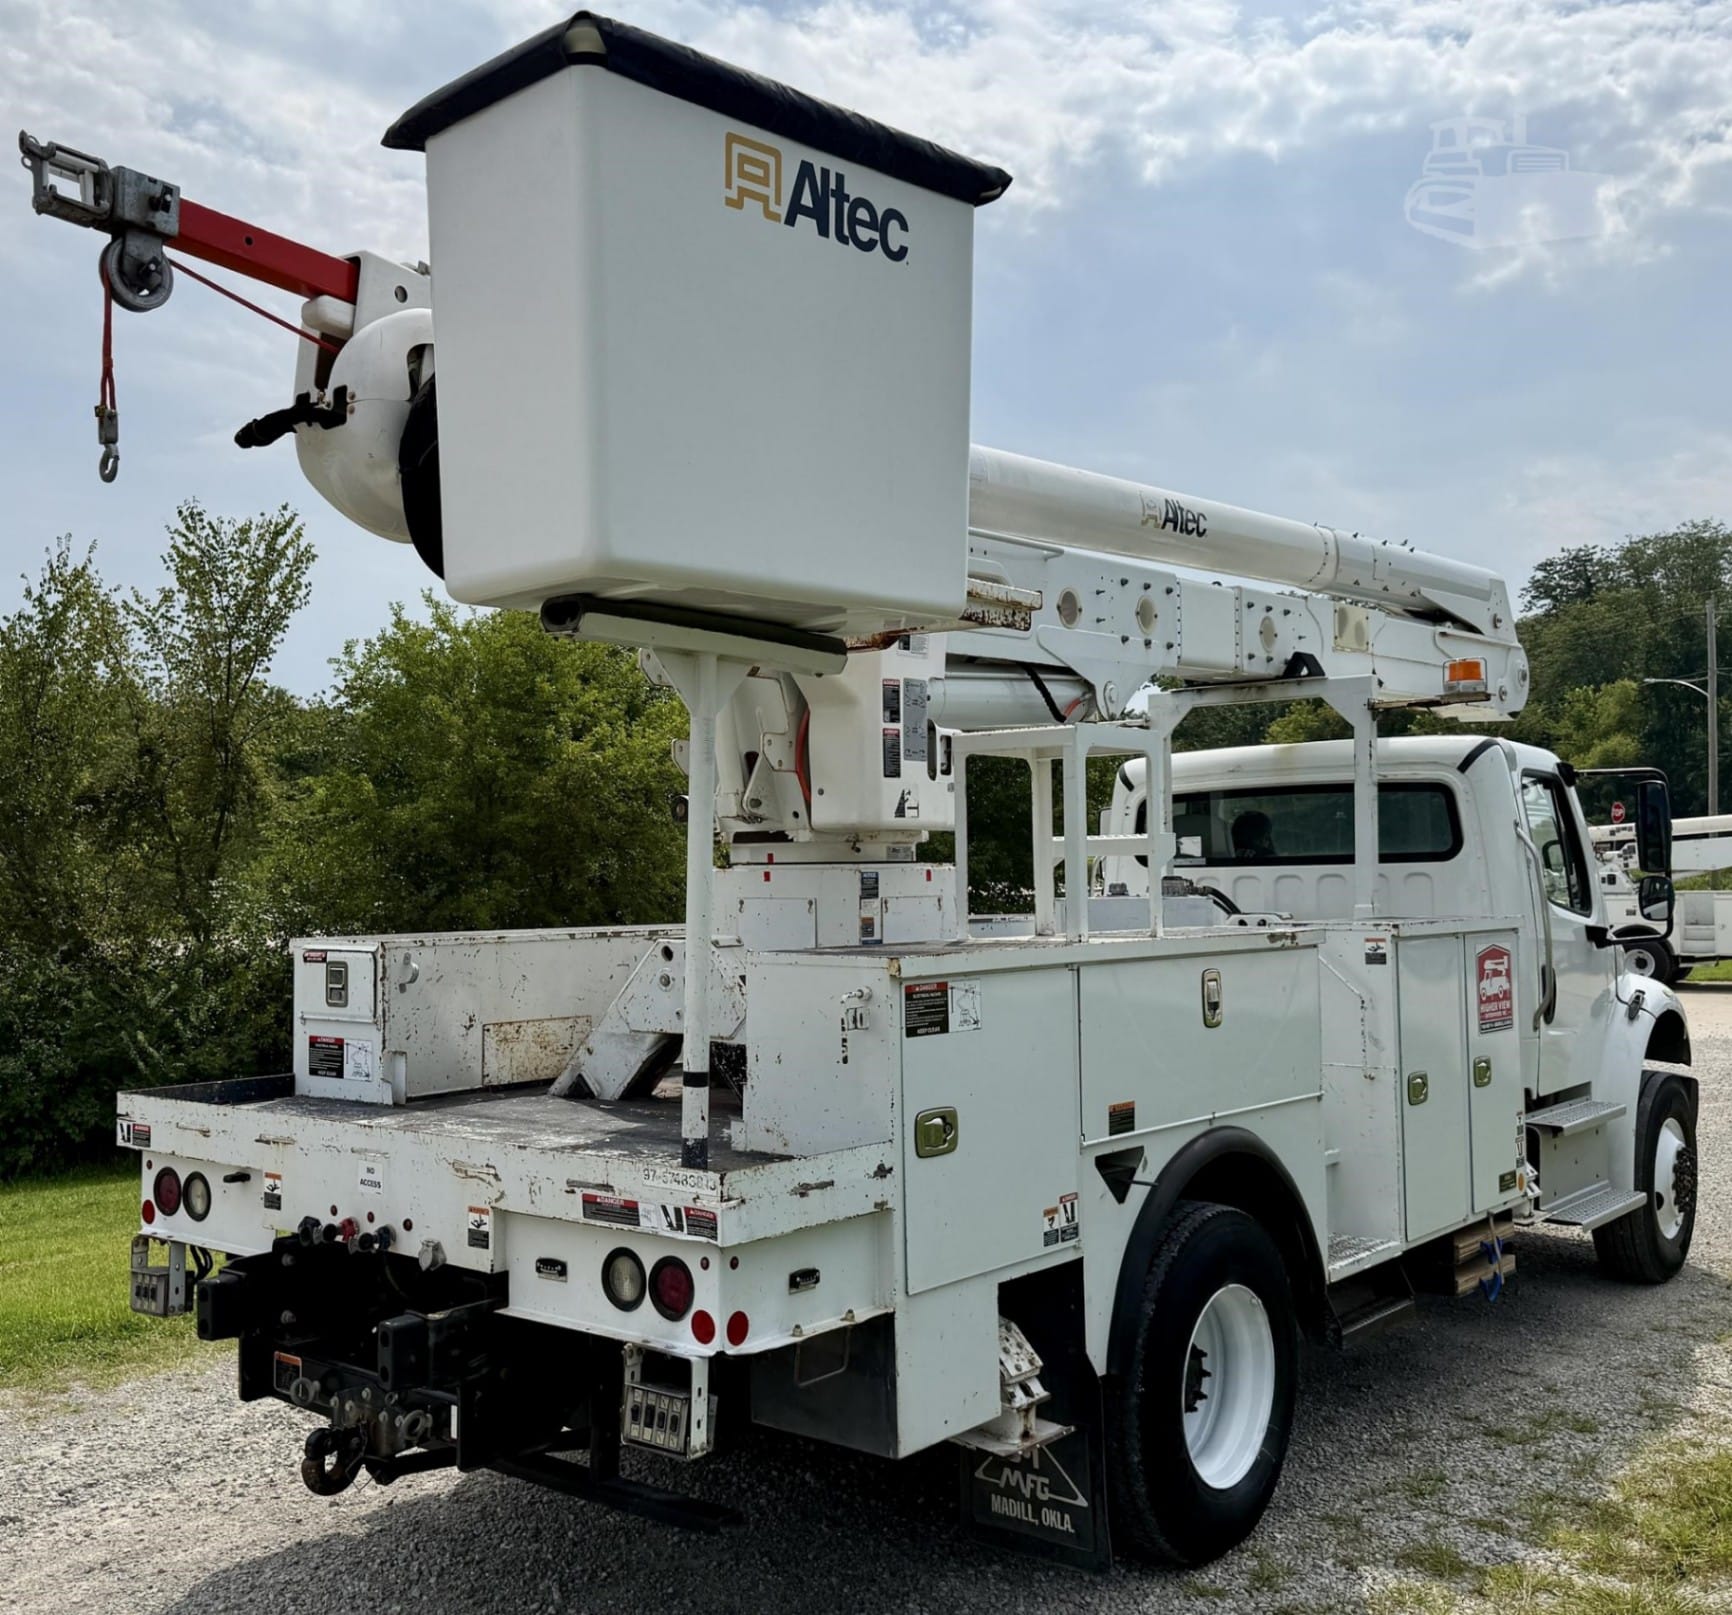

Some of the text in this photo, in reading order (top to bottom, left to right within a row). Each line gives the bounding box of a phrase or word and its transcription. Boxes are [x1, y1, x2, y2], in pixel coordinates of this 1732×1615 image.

[784, 159, 909, 262] Altec
[1161, 498, 1207, 537] Altec
[1000, 1467, 1050, 1501] MFG
[991, 1493, 1075, 1533] MADILL, OKLA.
